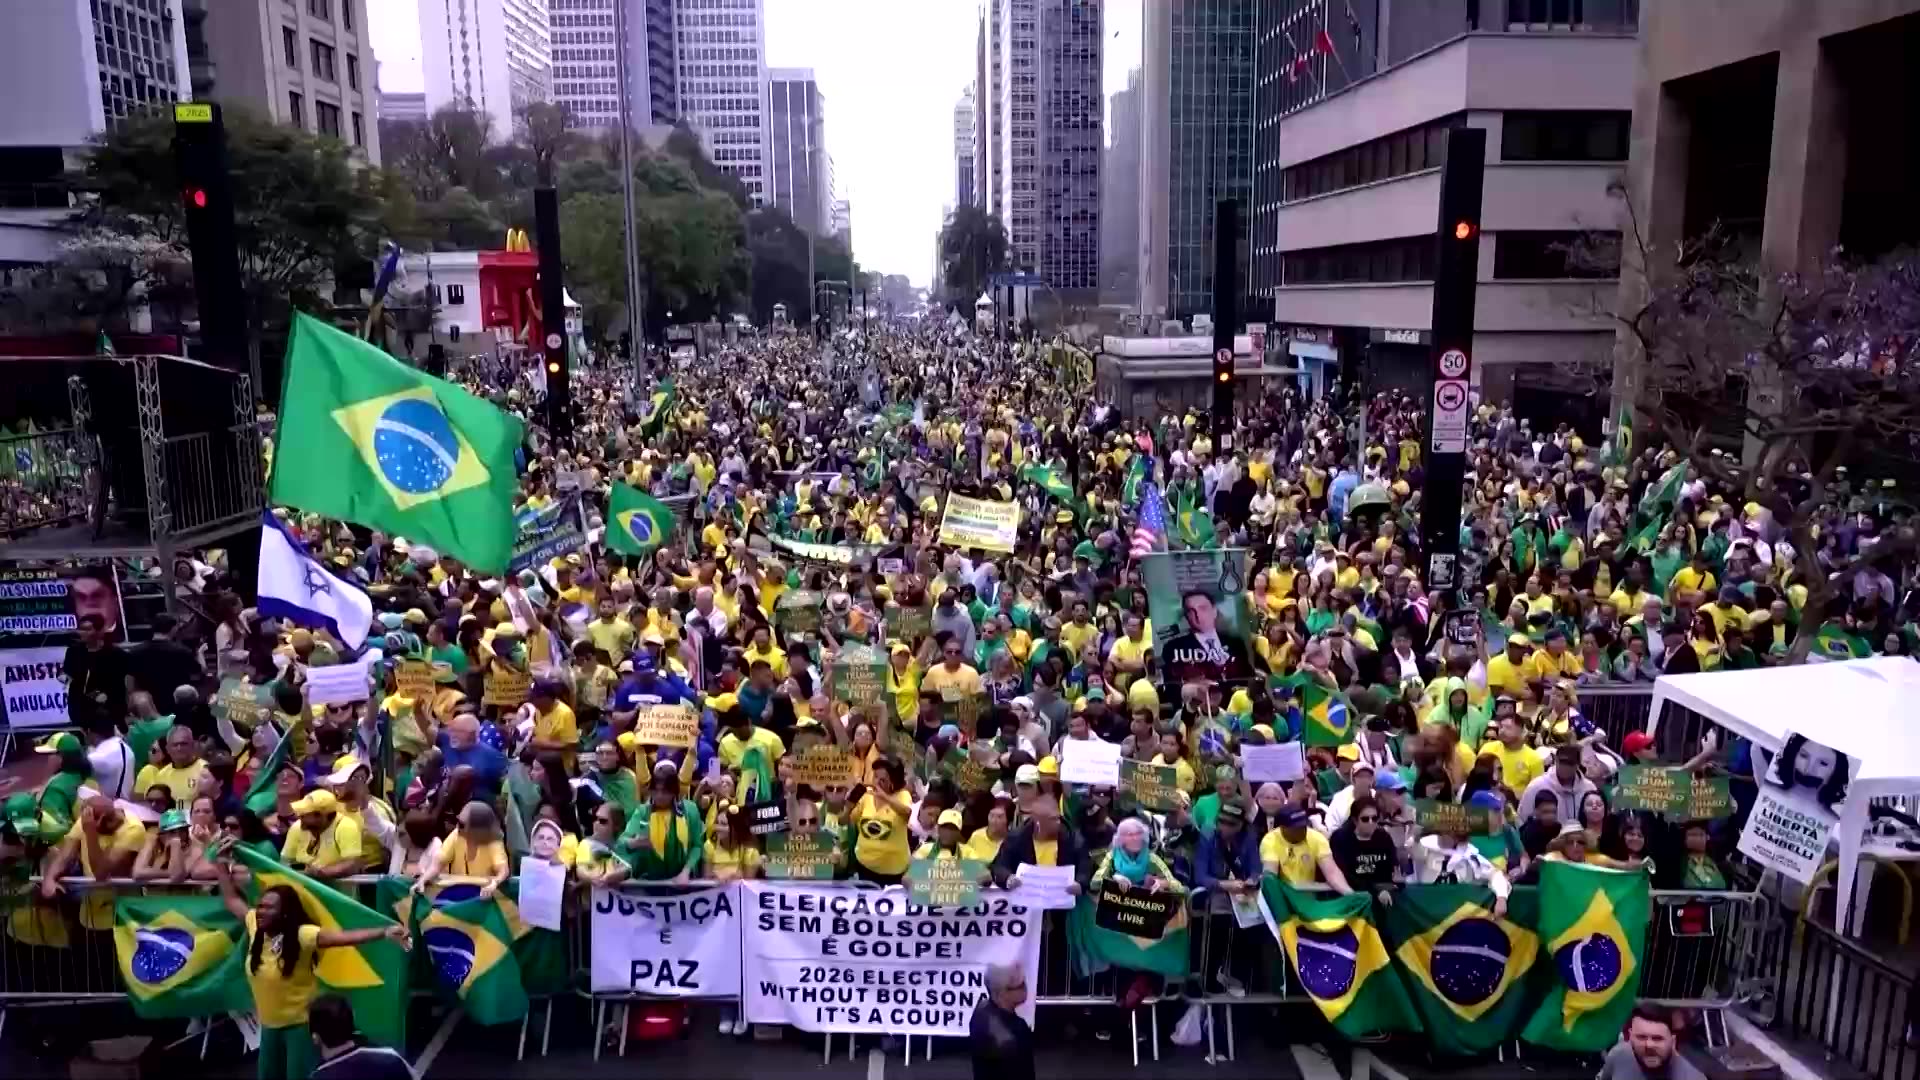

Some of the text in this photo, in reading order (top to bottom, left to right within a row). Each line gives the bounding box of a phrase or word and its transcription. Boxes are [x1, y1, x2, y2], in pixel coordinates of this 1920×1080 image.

[1443, 354, 1464, 369] 50
[757, 805, 780, 819] FORA
[1753, 826, 1814, 861] ZAMBELLI
[596, 891, 733, 924] JUSTIÇA
[759, 891, 895, 917] ELEIÇÃO
[1103, 889, 1166, 913] BOLSONARO
[758, 912, 1027, 938] SEM BOLSONARO
[1117, 911, 1146, 925] LIVRE
[821, 934, 962, 959] É GOLPE!
[630, 958, 700, 989] PAZ
[799, 966, 983, 987] 2026 ELECTION
[760, 980, 869, 1003] WITHOUT
[816, 1006, 964, 1027] IT'S A COUP!
